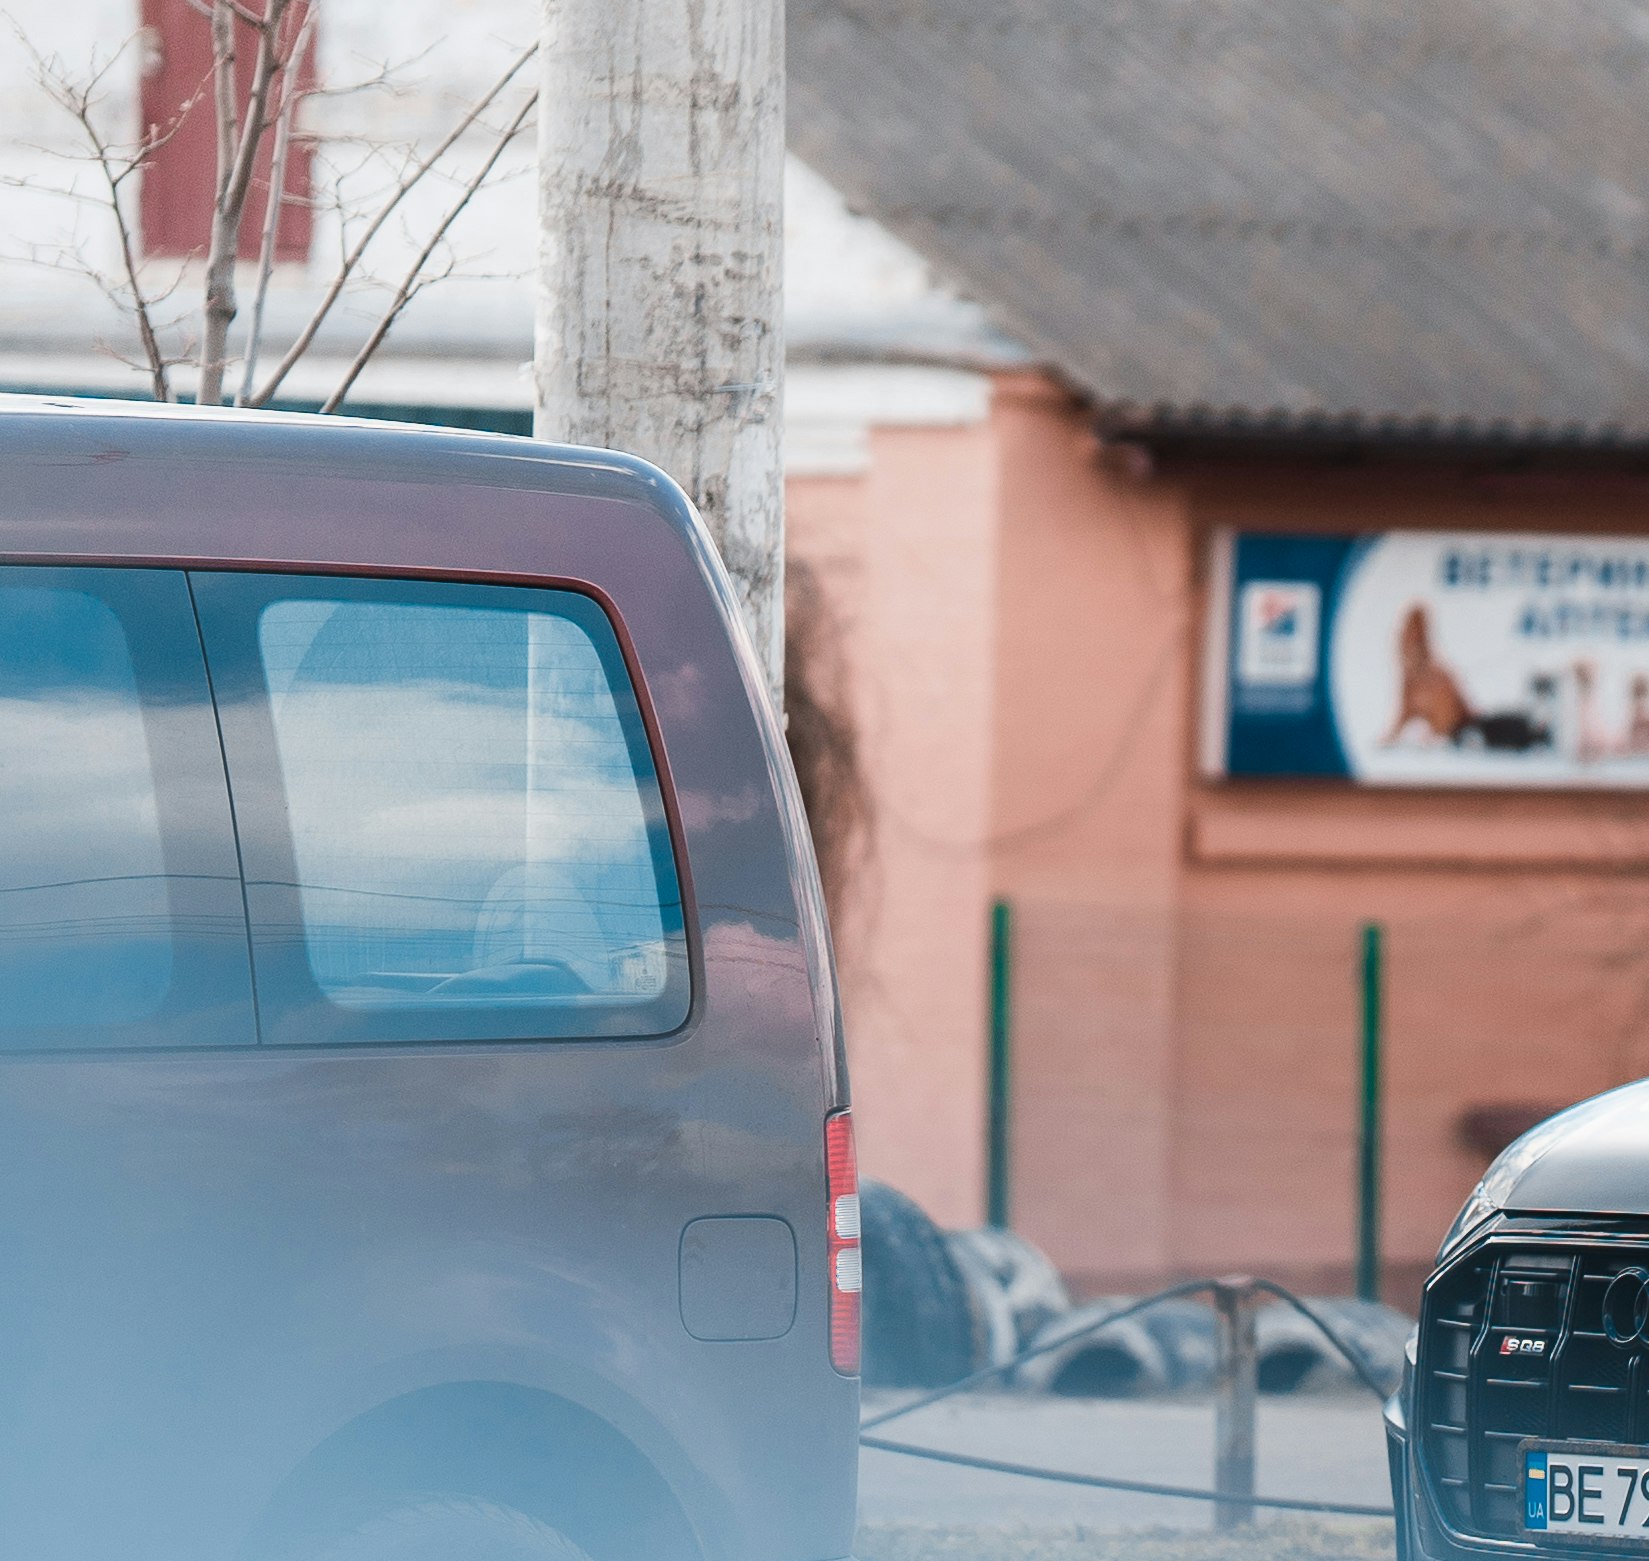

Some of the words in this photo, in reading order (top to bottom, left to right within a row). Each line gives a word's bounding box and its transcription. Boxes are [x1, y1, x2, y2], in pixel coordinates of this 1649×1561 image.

[1506, 1337, 1546, 1354] SQ8
[1549, 1463, 1605, 1525] BE
[1528, 1501, 1545, 1520] UA
